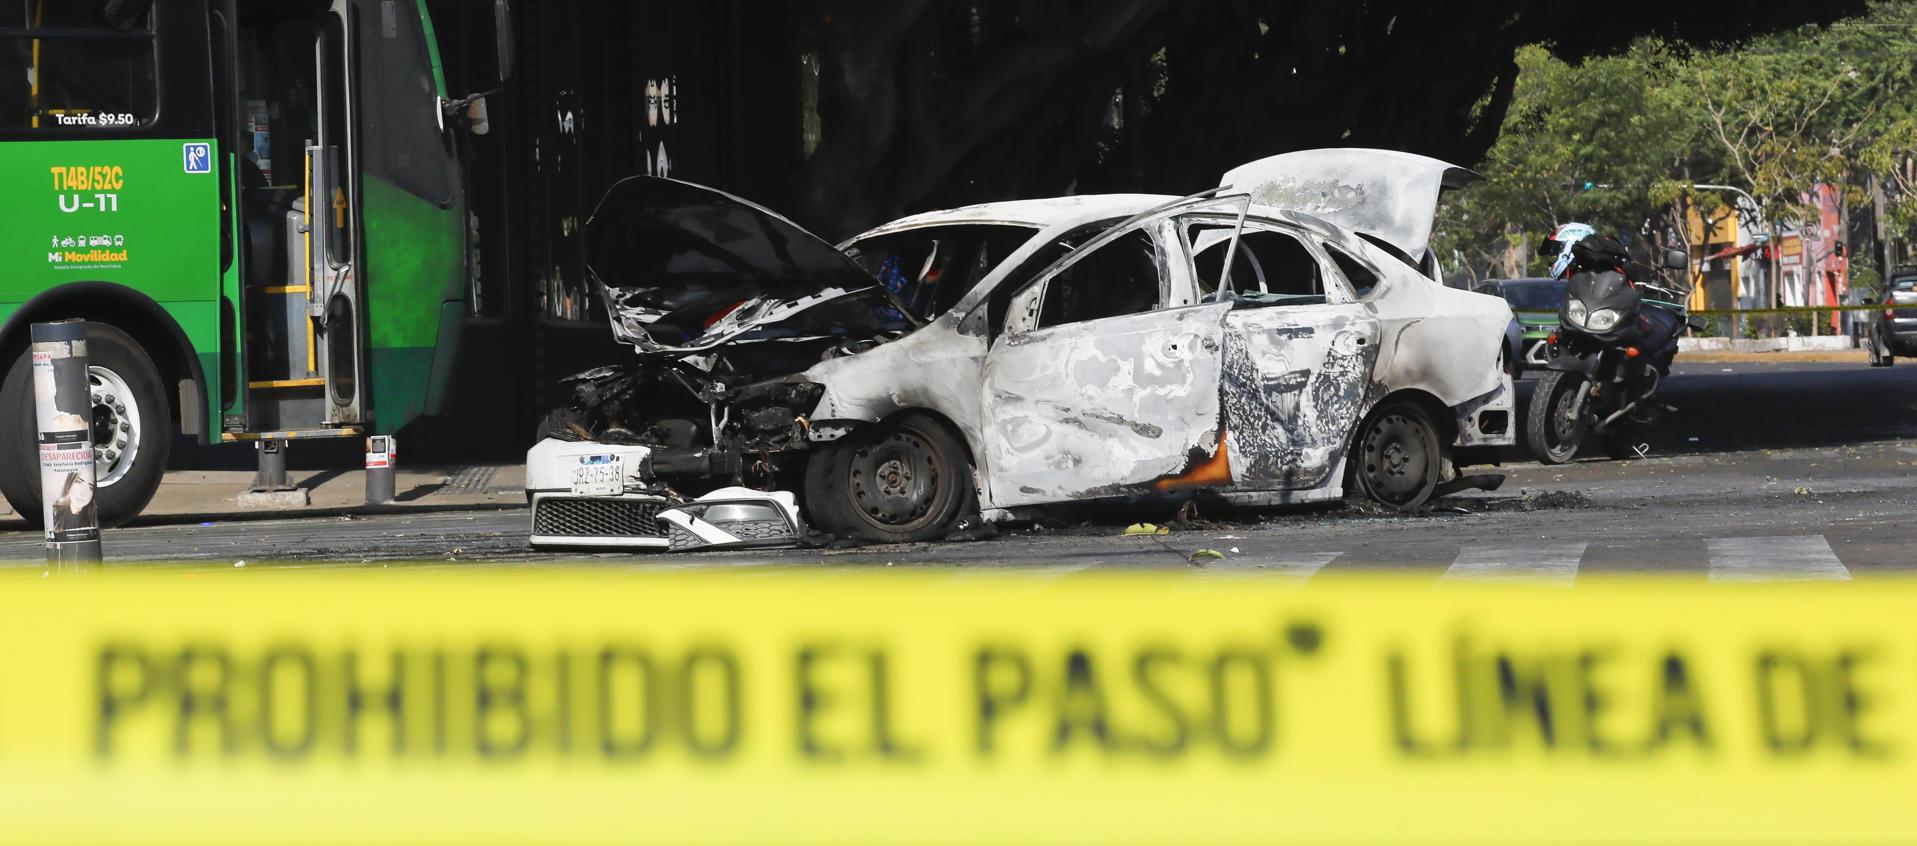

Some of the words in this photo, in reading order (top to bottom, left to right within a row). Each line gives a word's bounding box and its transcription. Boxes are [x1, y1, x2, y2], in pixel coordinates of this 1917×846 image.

[55, 112, 97, 125] Tarifa
[98, 111, 134, 126] $9.50
[51, 165, 124, 191] T14B/52C
[58, 193, 118, 213] U-11
[48, 251, 63, 262] Mi
[64, 249, 128, 262] Movilidad
[41, 450, 92, 462] DESAPARECIDA
[95, 643, 743, 762] PROHIBIDO
[792, 644, 922, 762] EL
[972, 644, 1276, 761] PASO
[1751, 647, 1894, 758] DE
